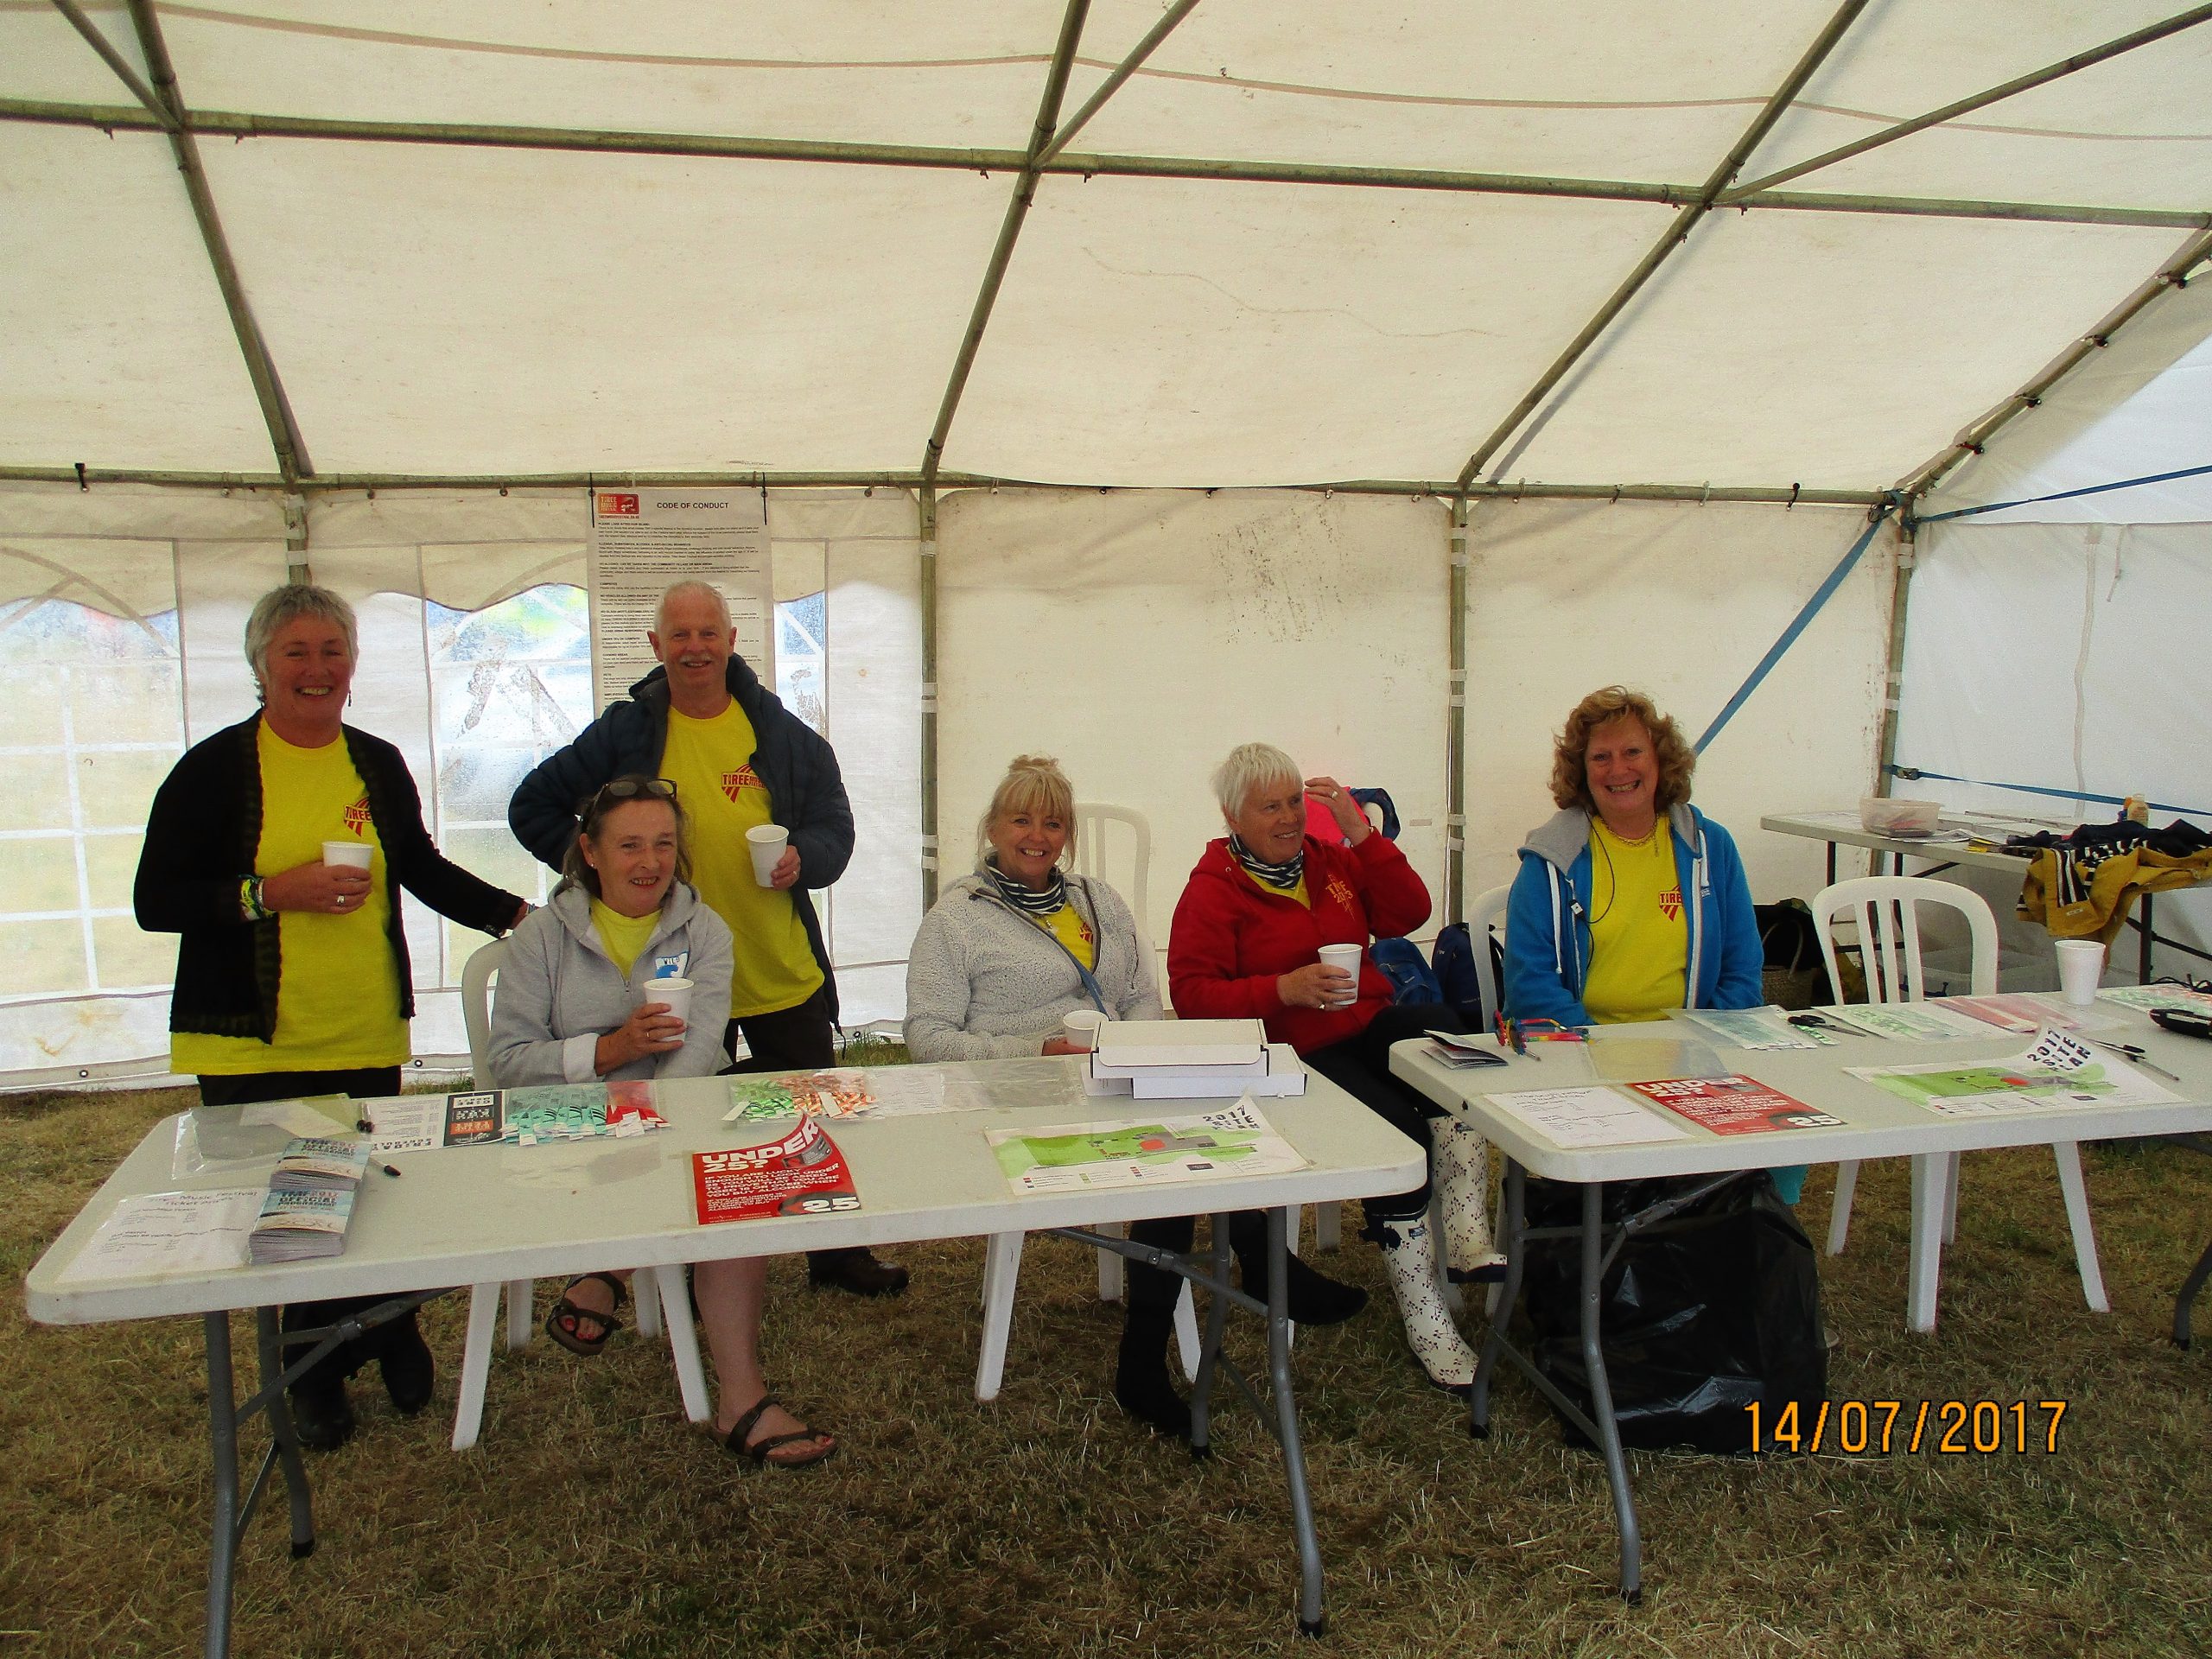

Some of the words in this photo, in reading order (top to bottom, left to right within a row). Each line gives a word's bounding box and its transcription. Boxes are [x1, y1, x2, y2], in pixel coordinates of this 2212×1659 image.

[722, 774, 750, 785] TIREE
[1660, 893, 1682, 904] TIRE
[2026, 1027, 2061, 1062] 2017
[2042, 1037, 2076, 1066] SITE
[1635, 1077, 1748, 1090] UNDER
[1649, 1088, 1705, 1097] 25?
[1202, 1104, 1246, 1122] 2017
[1786, 1115, 1843, 1127] 25
[702, 1117, 818, 1164] UNDER
[703, 1160, 769, 1173] 25?
[803, 1163, 839, 1174] UNDER
[802, 1196, 861, 1212] 25
